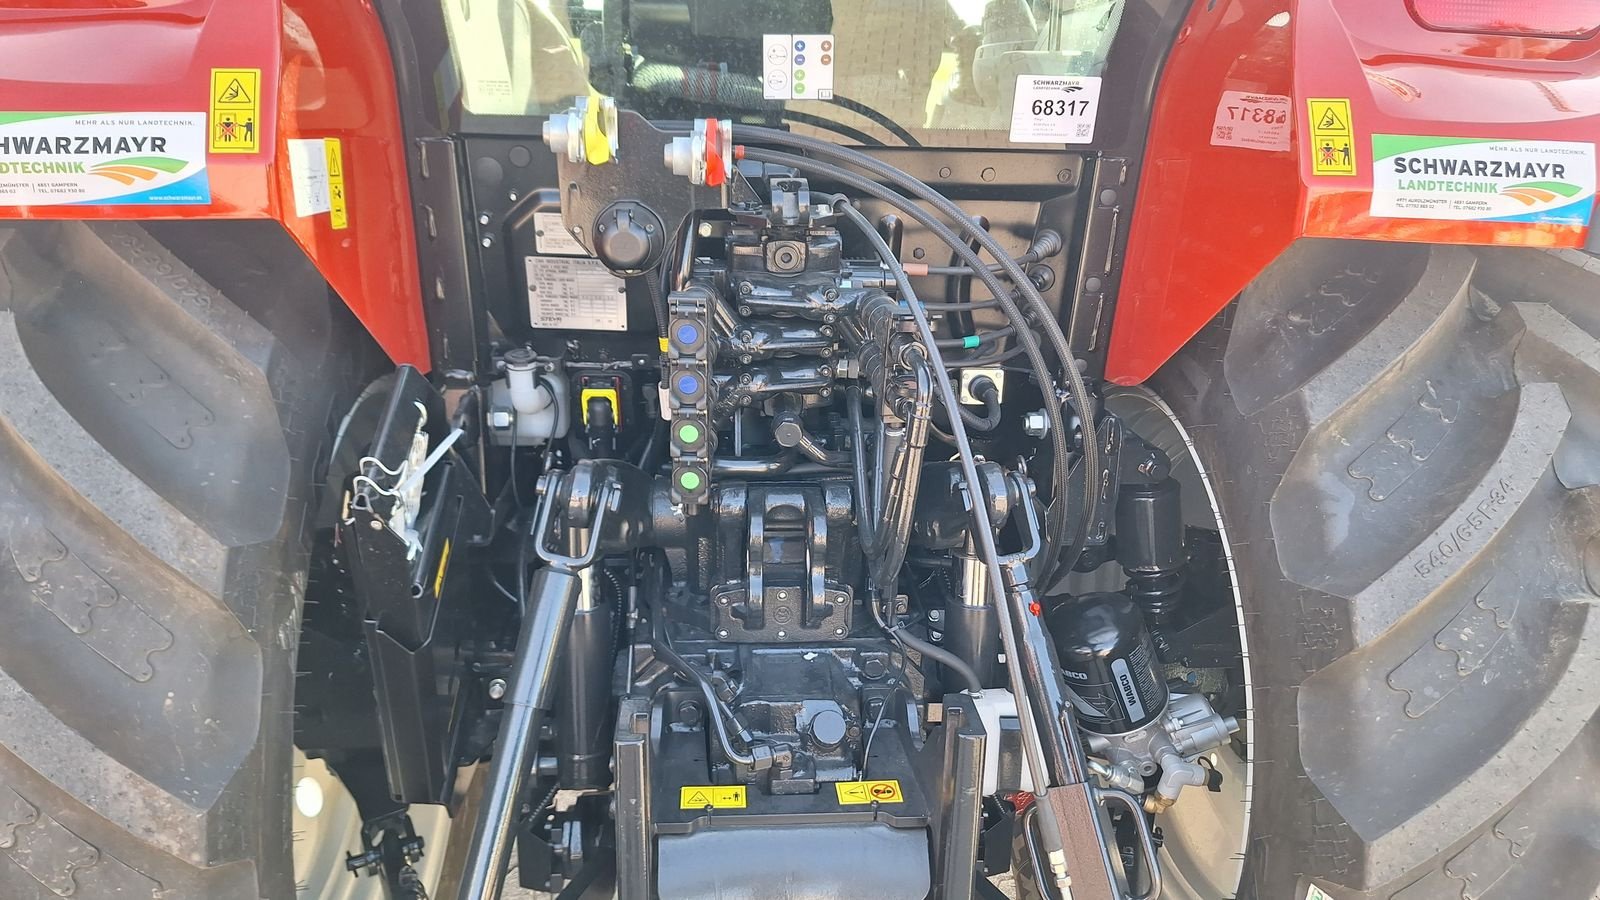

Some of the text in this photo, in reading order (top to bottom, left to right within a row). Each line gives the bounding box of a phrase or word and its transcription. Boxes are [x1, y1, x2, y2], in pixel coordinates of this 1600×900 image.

[1031, 99, 1090, 116] 68317
[0, 161, 86, 174] DTECHNIK
[1394, 156, 1565, 179] SCHWARZMAYR
[1398, 179, 1498, 194] LANDTECHNIK
[1119, 674, 1137, 707] WABCO
